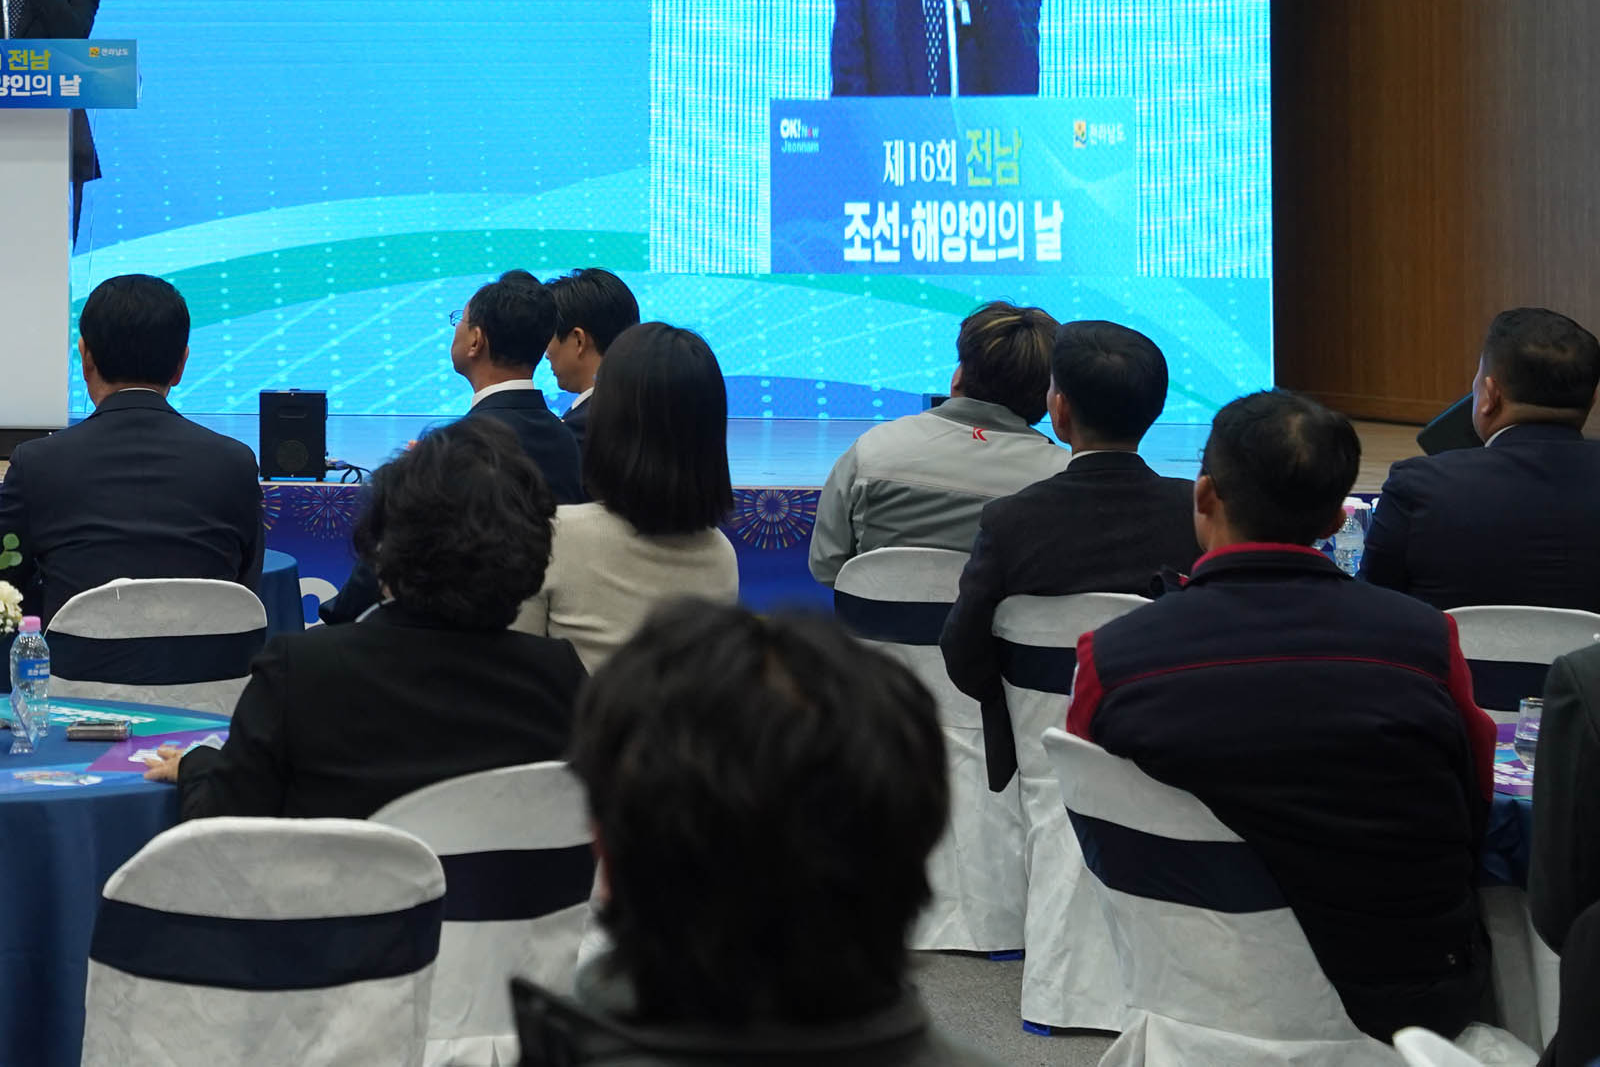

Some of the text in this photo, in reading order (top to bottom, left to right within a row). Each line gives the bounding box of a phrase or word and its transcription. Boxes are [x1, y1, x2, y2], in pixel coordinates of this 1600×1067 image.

[7, 49, 51, 71] 전남
[59, 75, 82, 97] 날
[883, 128, 1021, 186] 제16회 전남
[1034, 200, 1064, 261] 날
